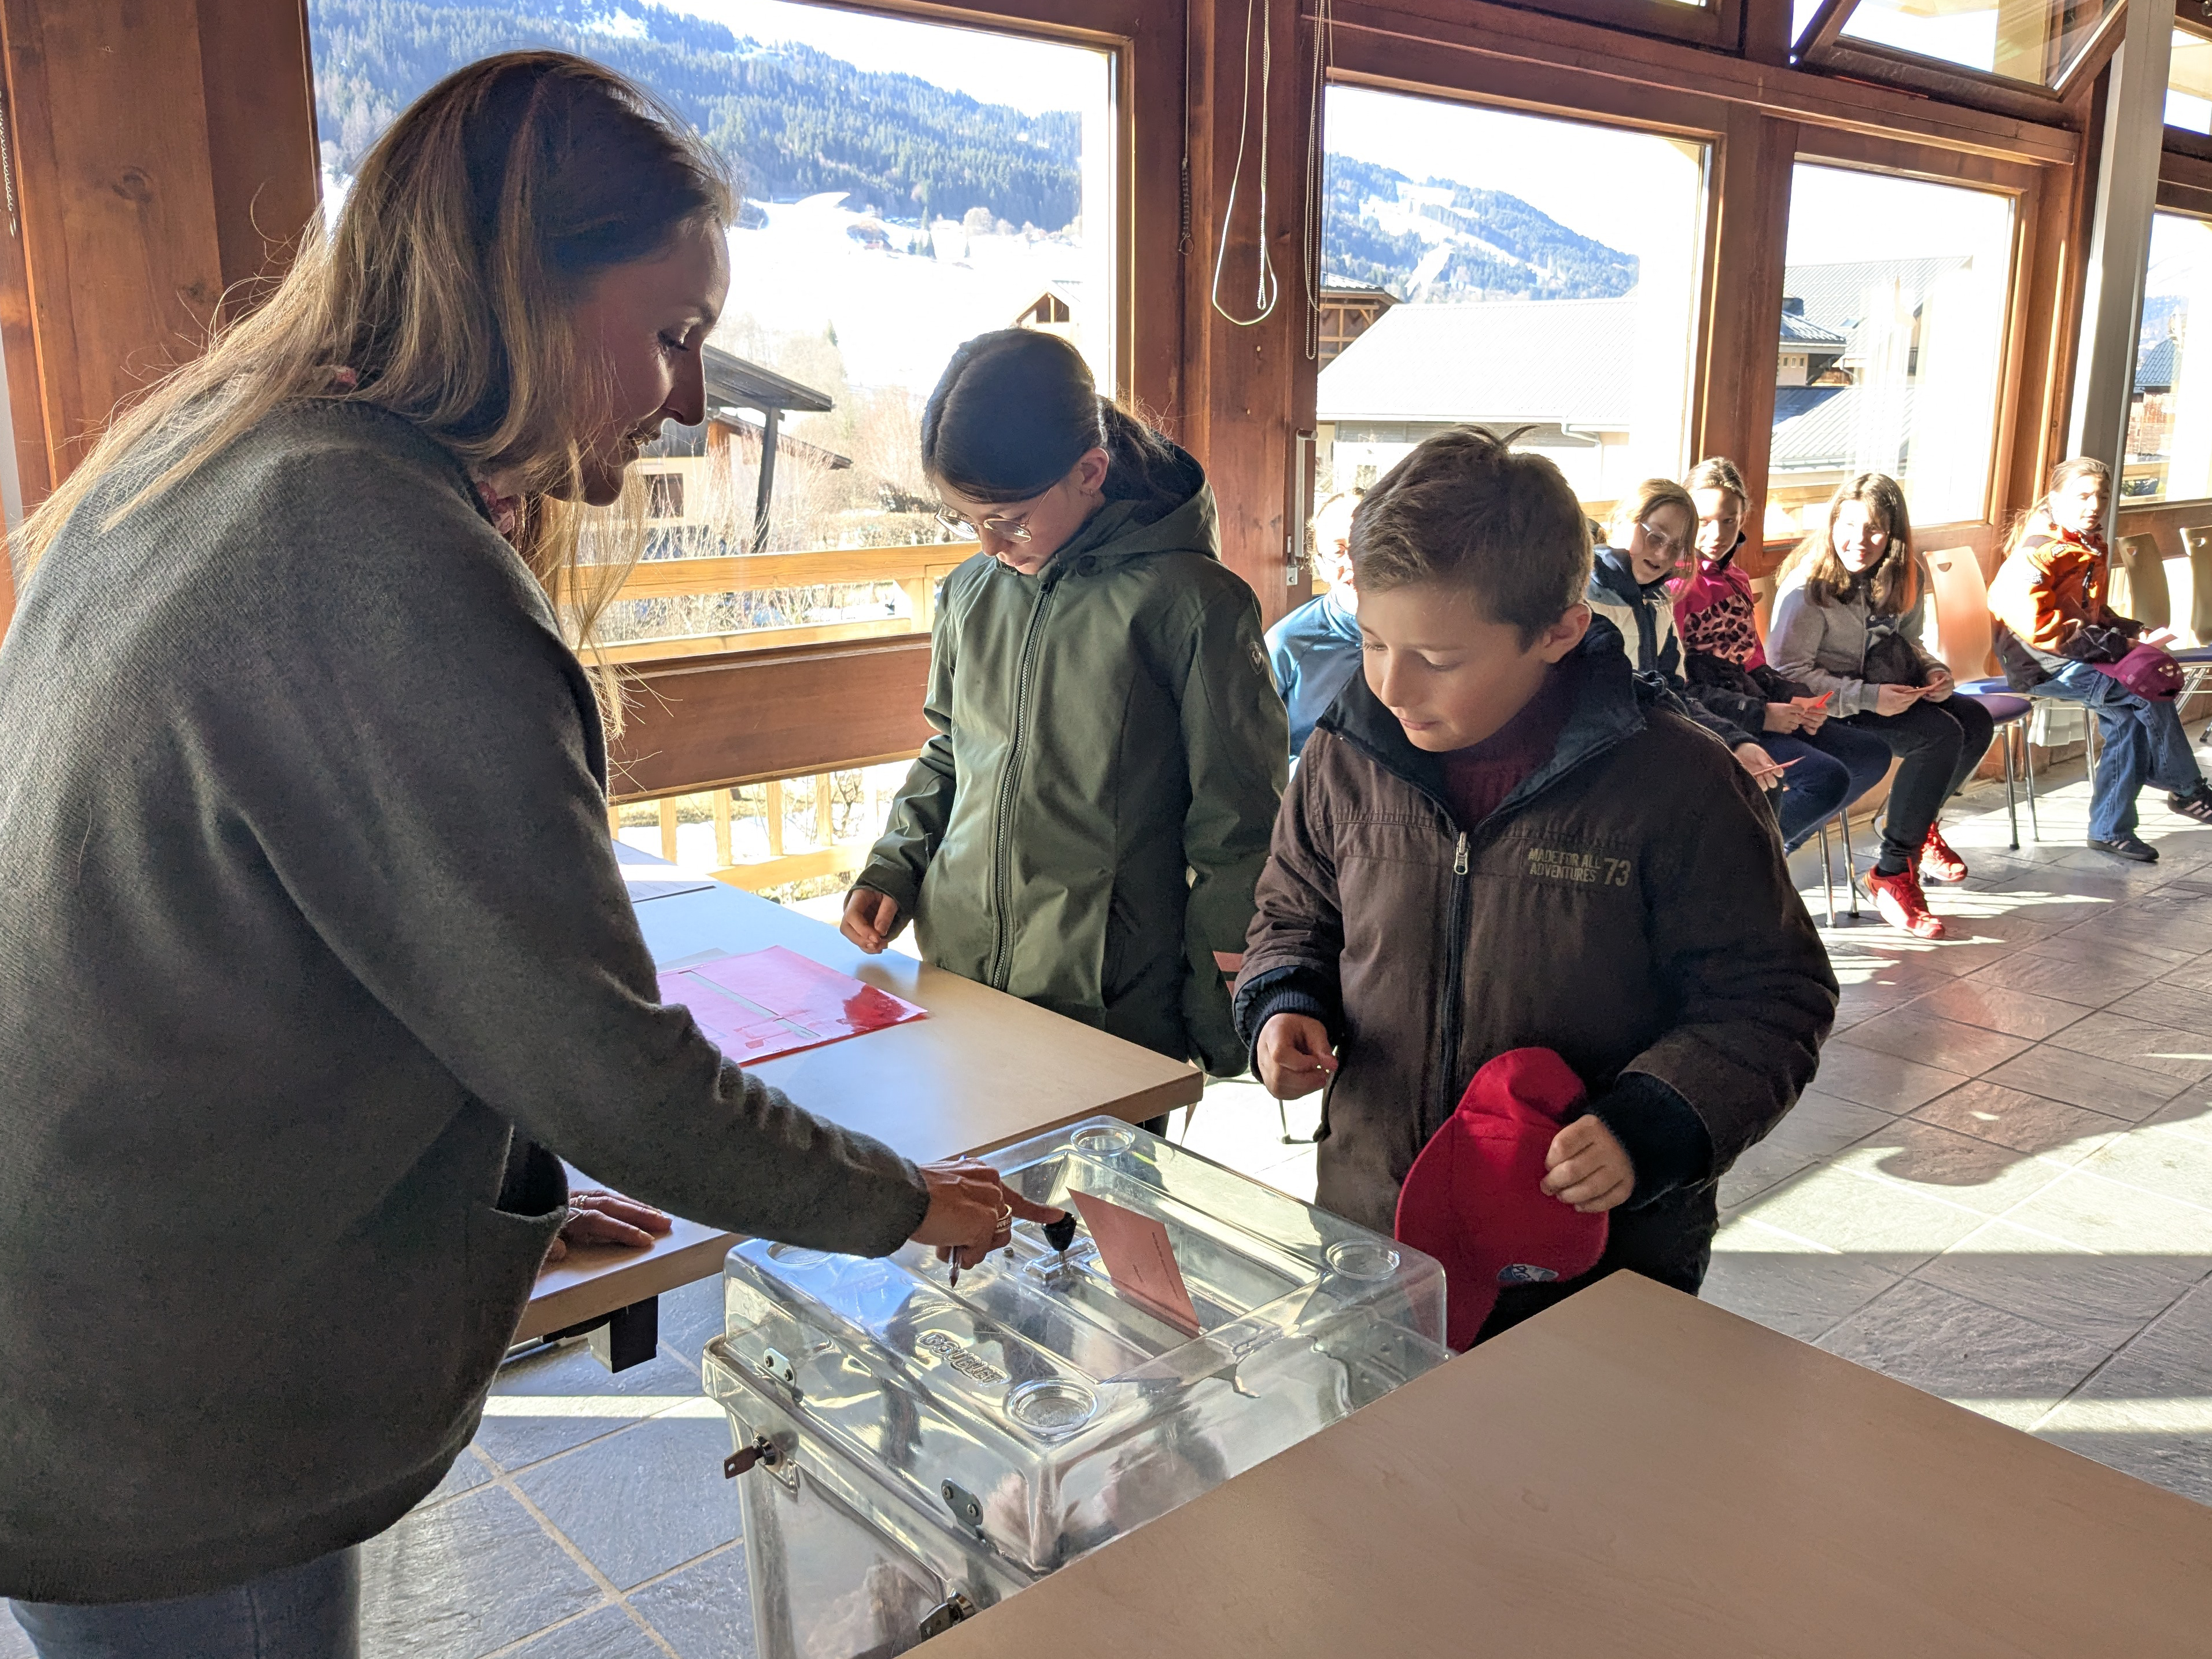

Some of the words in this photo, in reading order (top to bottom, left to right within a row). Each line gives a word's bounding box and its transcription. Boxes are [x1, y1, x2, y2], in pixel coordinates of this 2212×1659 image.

[1528, 848, 1559, 862] MADE
[1581, 854, 1601, 869] ALL
[1529, 862, 1597, 882] ADVENTURES
[1604, 858, 1631, 886] 73
[919, 1332, 1007, 1385] DOUBLET
